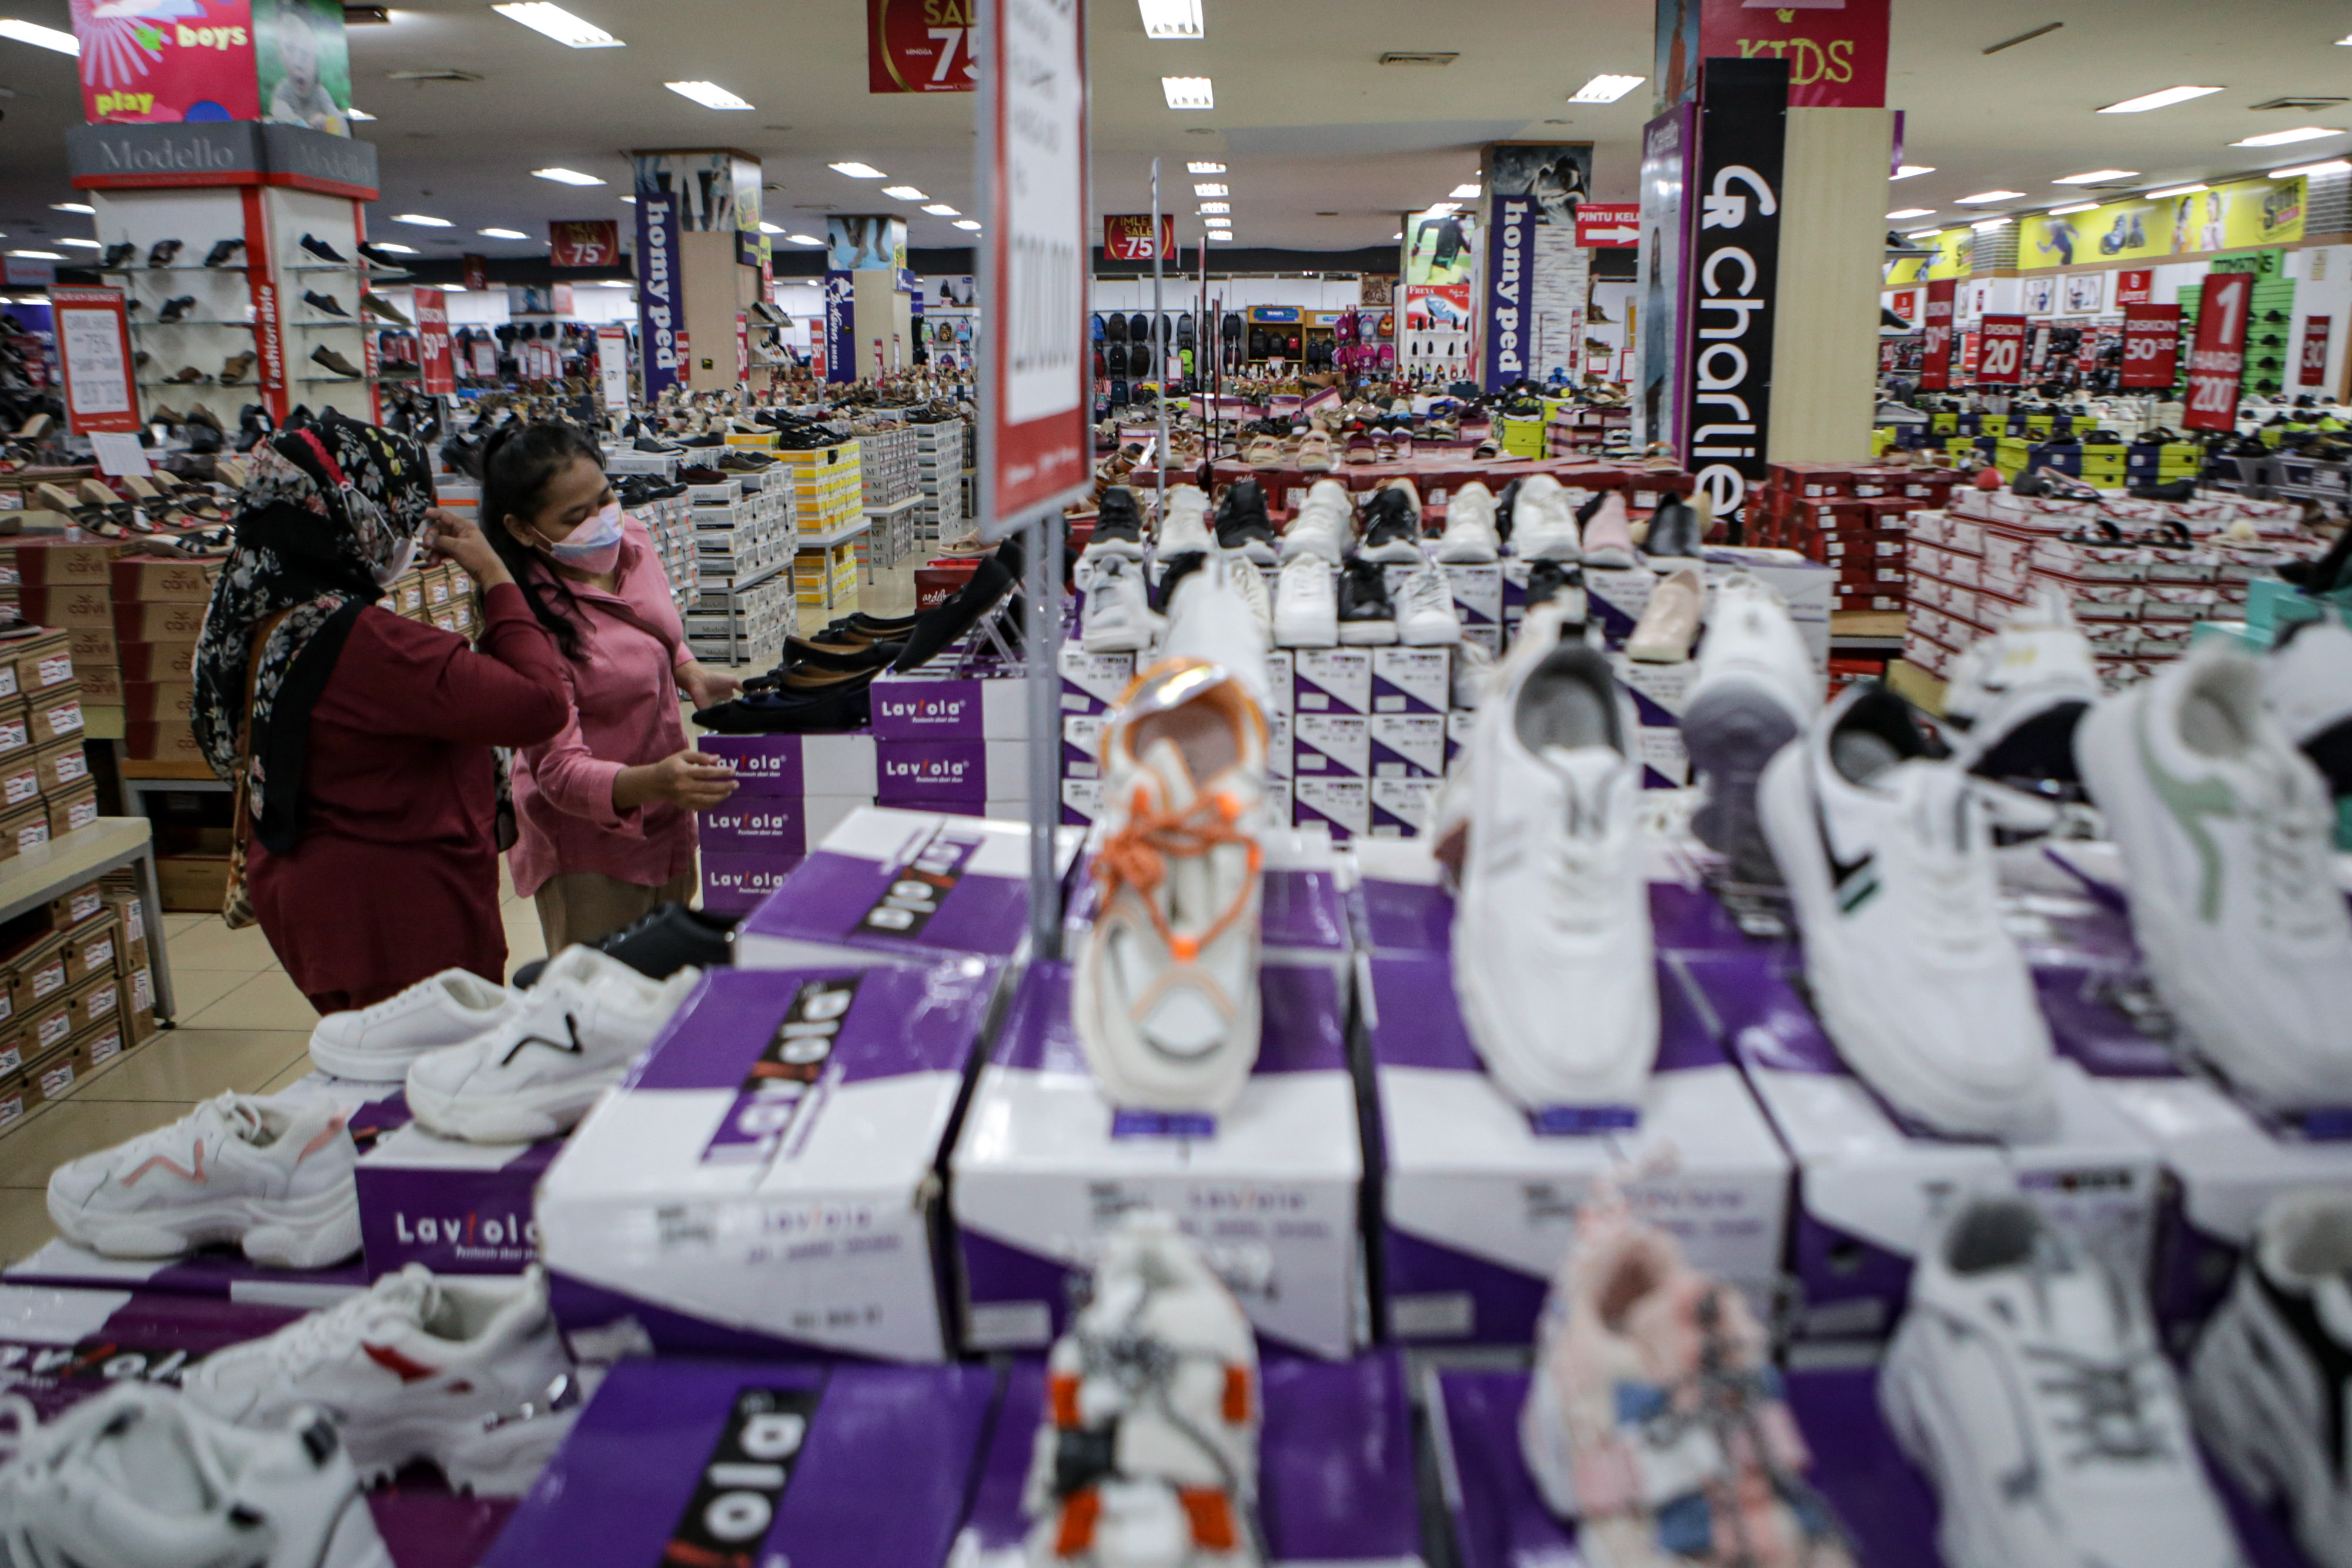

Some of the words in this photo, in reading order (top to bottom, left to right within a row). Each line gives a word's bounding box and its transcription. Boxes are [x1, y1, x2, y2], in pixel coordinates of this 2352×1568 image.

[177, 24, 248, 51] boys
[95, 90, 155, 116] play
[99, 138, 235, 171] Modello
[1577, 212, 1613, 222] PINTU
[1124, 226, 1154, 236] SALE
[646, 200, 677, 370] homyped
[1409, 285, 1435, 295] FREYA
[1495, 200, 1529, 373] homyped
[2216, 281, 2243, 334] 1
[2127, 319, 2178, 332] DISKON
[421, 333, 440, 360] 50
[1981, 339, 2018, 375] 20
[2124, 337, 2156, 360] 50
[716, 754, 781, 770] aviola
